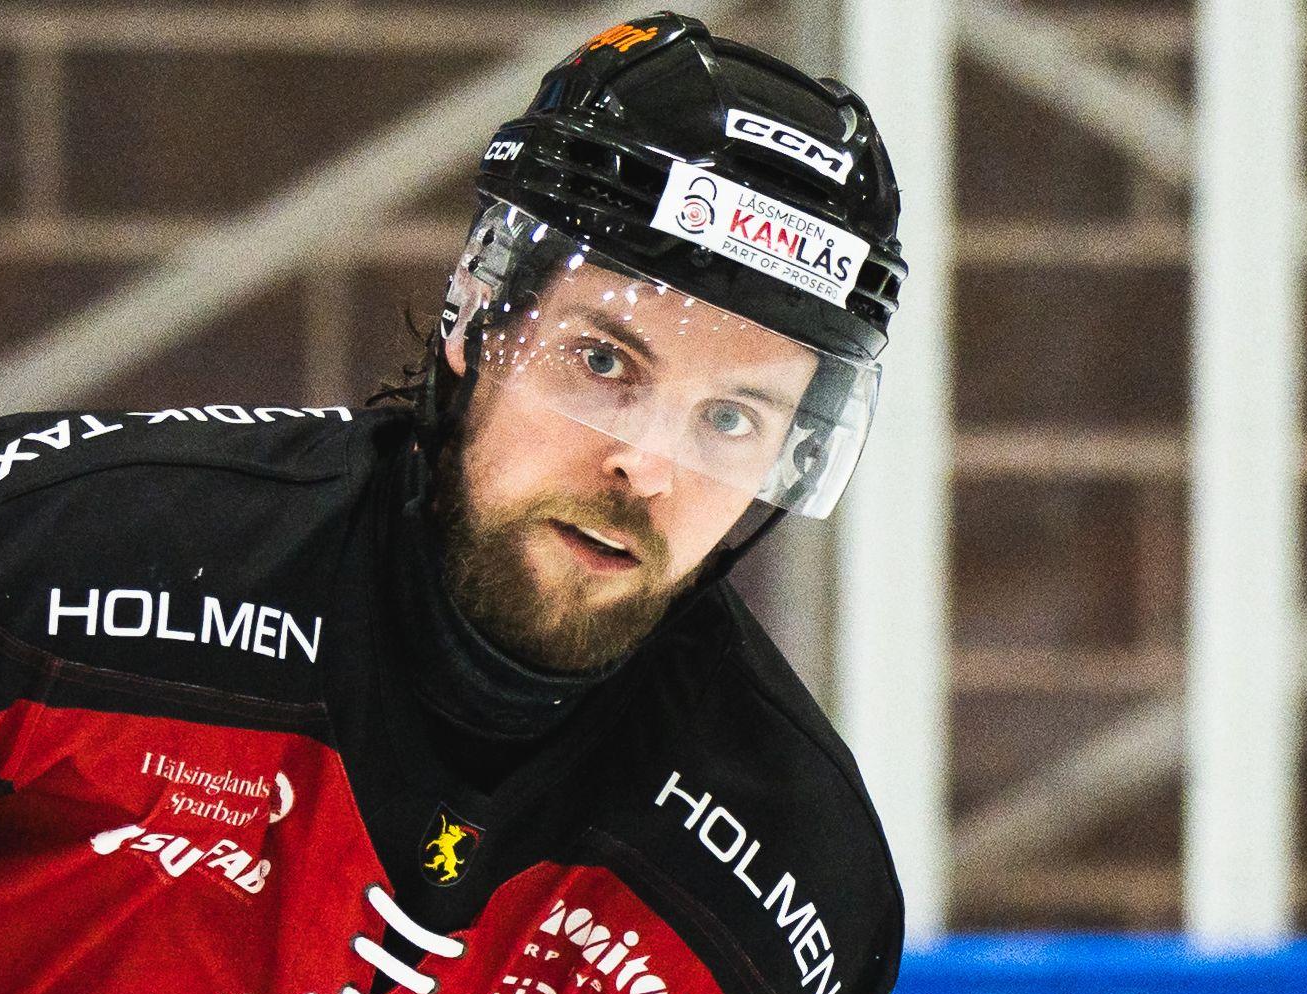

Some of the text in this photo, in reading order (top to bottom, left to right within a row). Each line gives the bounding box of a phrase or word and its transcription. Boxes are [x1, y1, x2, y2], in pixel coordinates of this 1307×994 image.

[484, 141, 525, 161] CCM
[733, 117, 844, 174] CCM
[738, 192, 827, 241] LÅSSMEDEN
[721, 240, 756, 263] PART
[759, 257, 780, 272] OF
[729, 208, 853, 283] KANLÅS
[47, 587, 323, 664] HOLMEN
[140, 751, 271, 800] Hälsinglands
